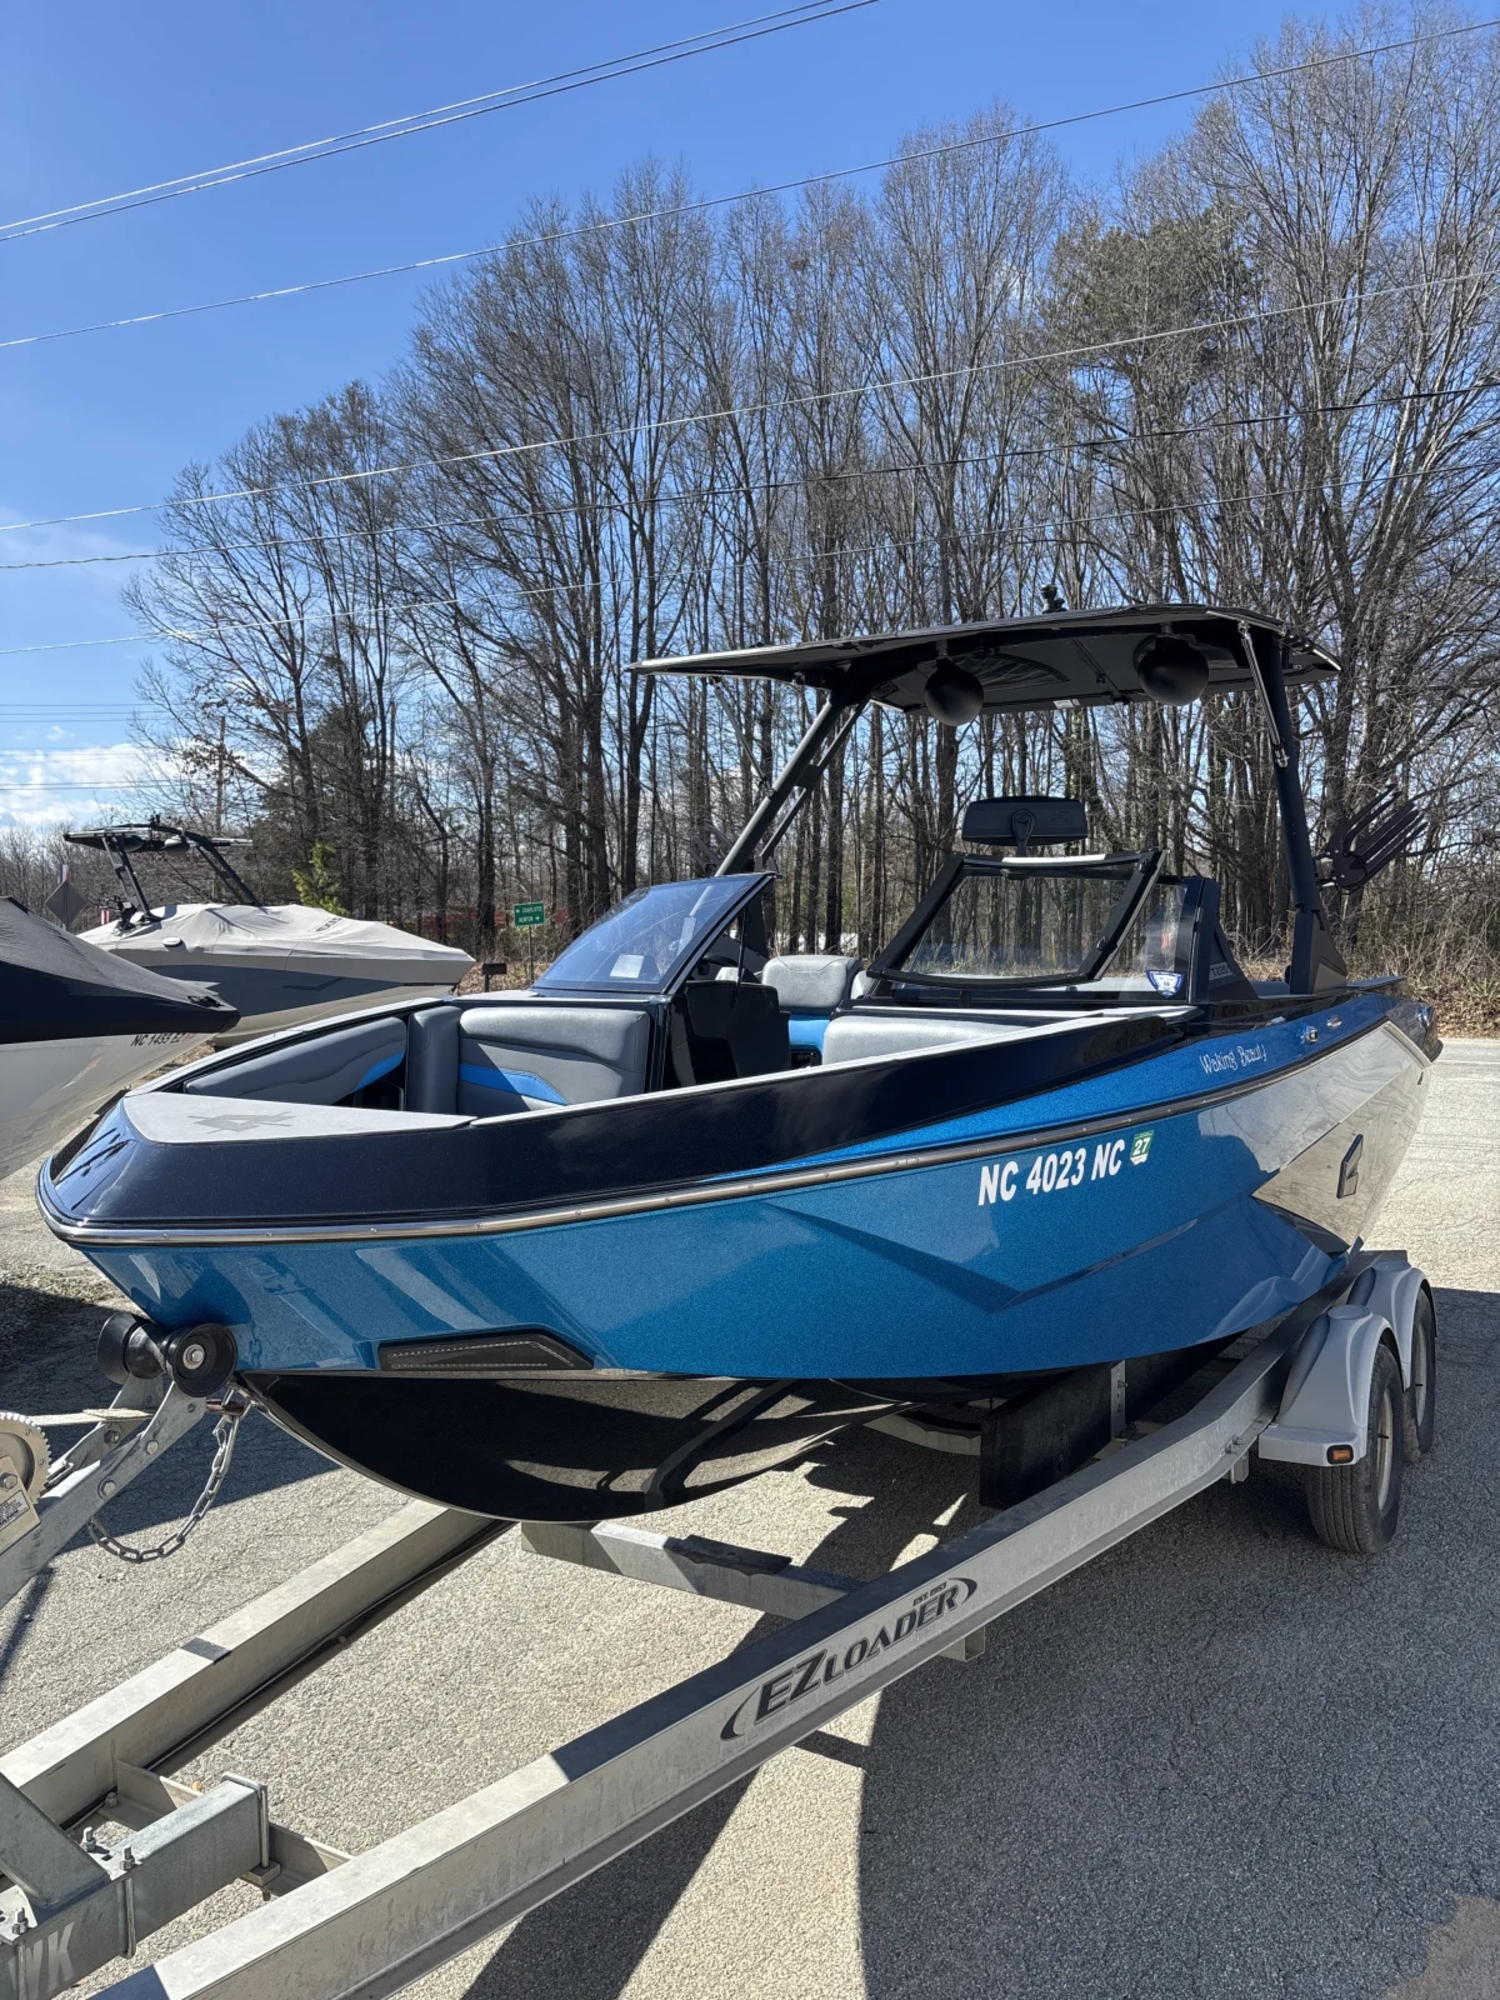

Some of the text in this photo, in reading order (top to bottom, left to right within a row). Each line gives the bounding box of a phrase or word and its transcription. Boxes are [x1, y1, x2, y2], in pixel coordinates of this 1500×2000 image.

[1199, 1049, 1238, 1074] Waking
[1132, 1137, 1151, 1156] 27
[978, 1139, 1125, 1206] NC 4023 NC
